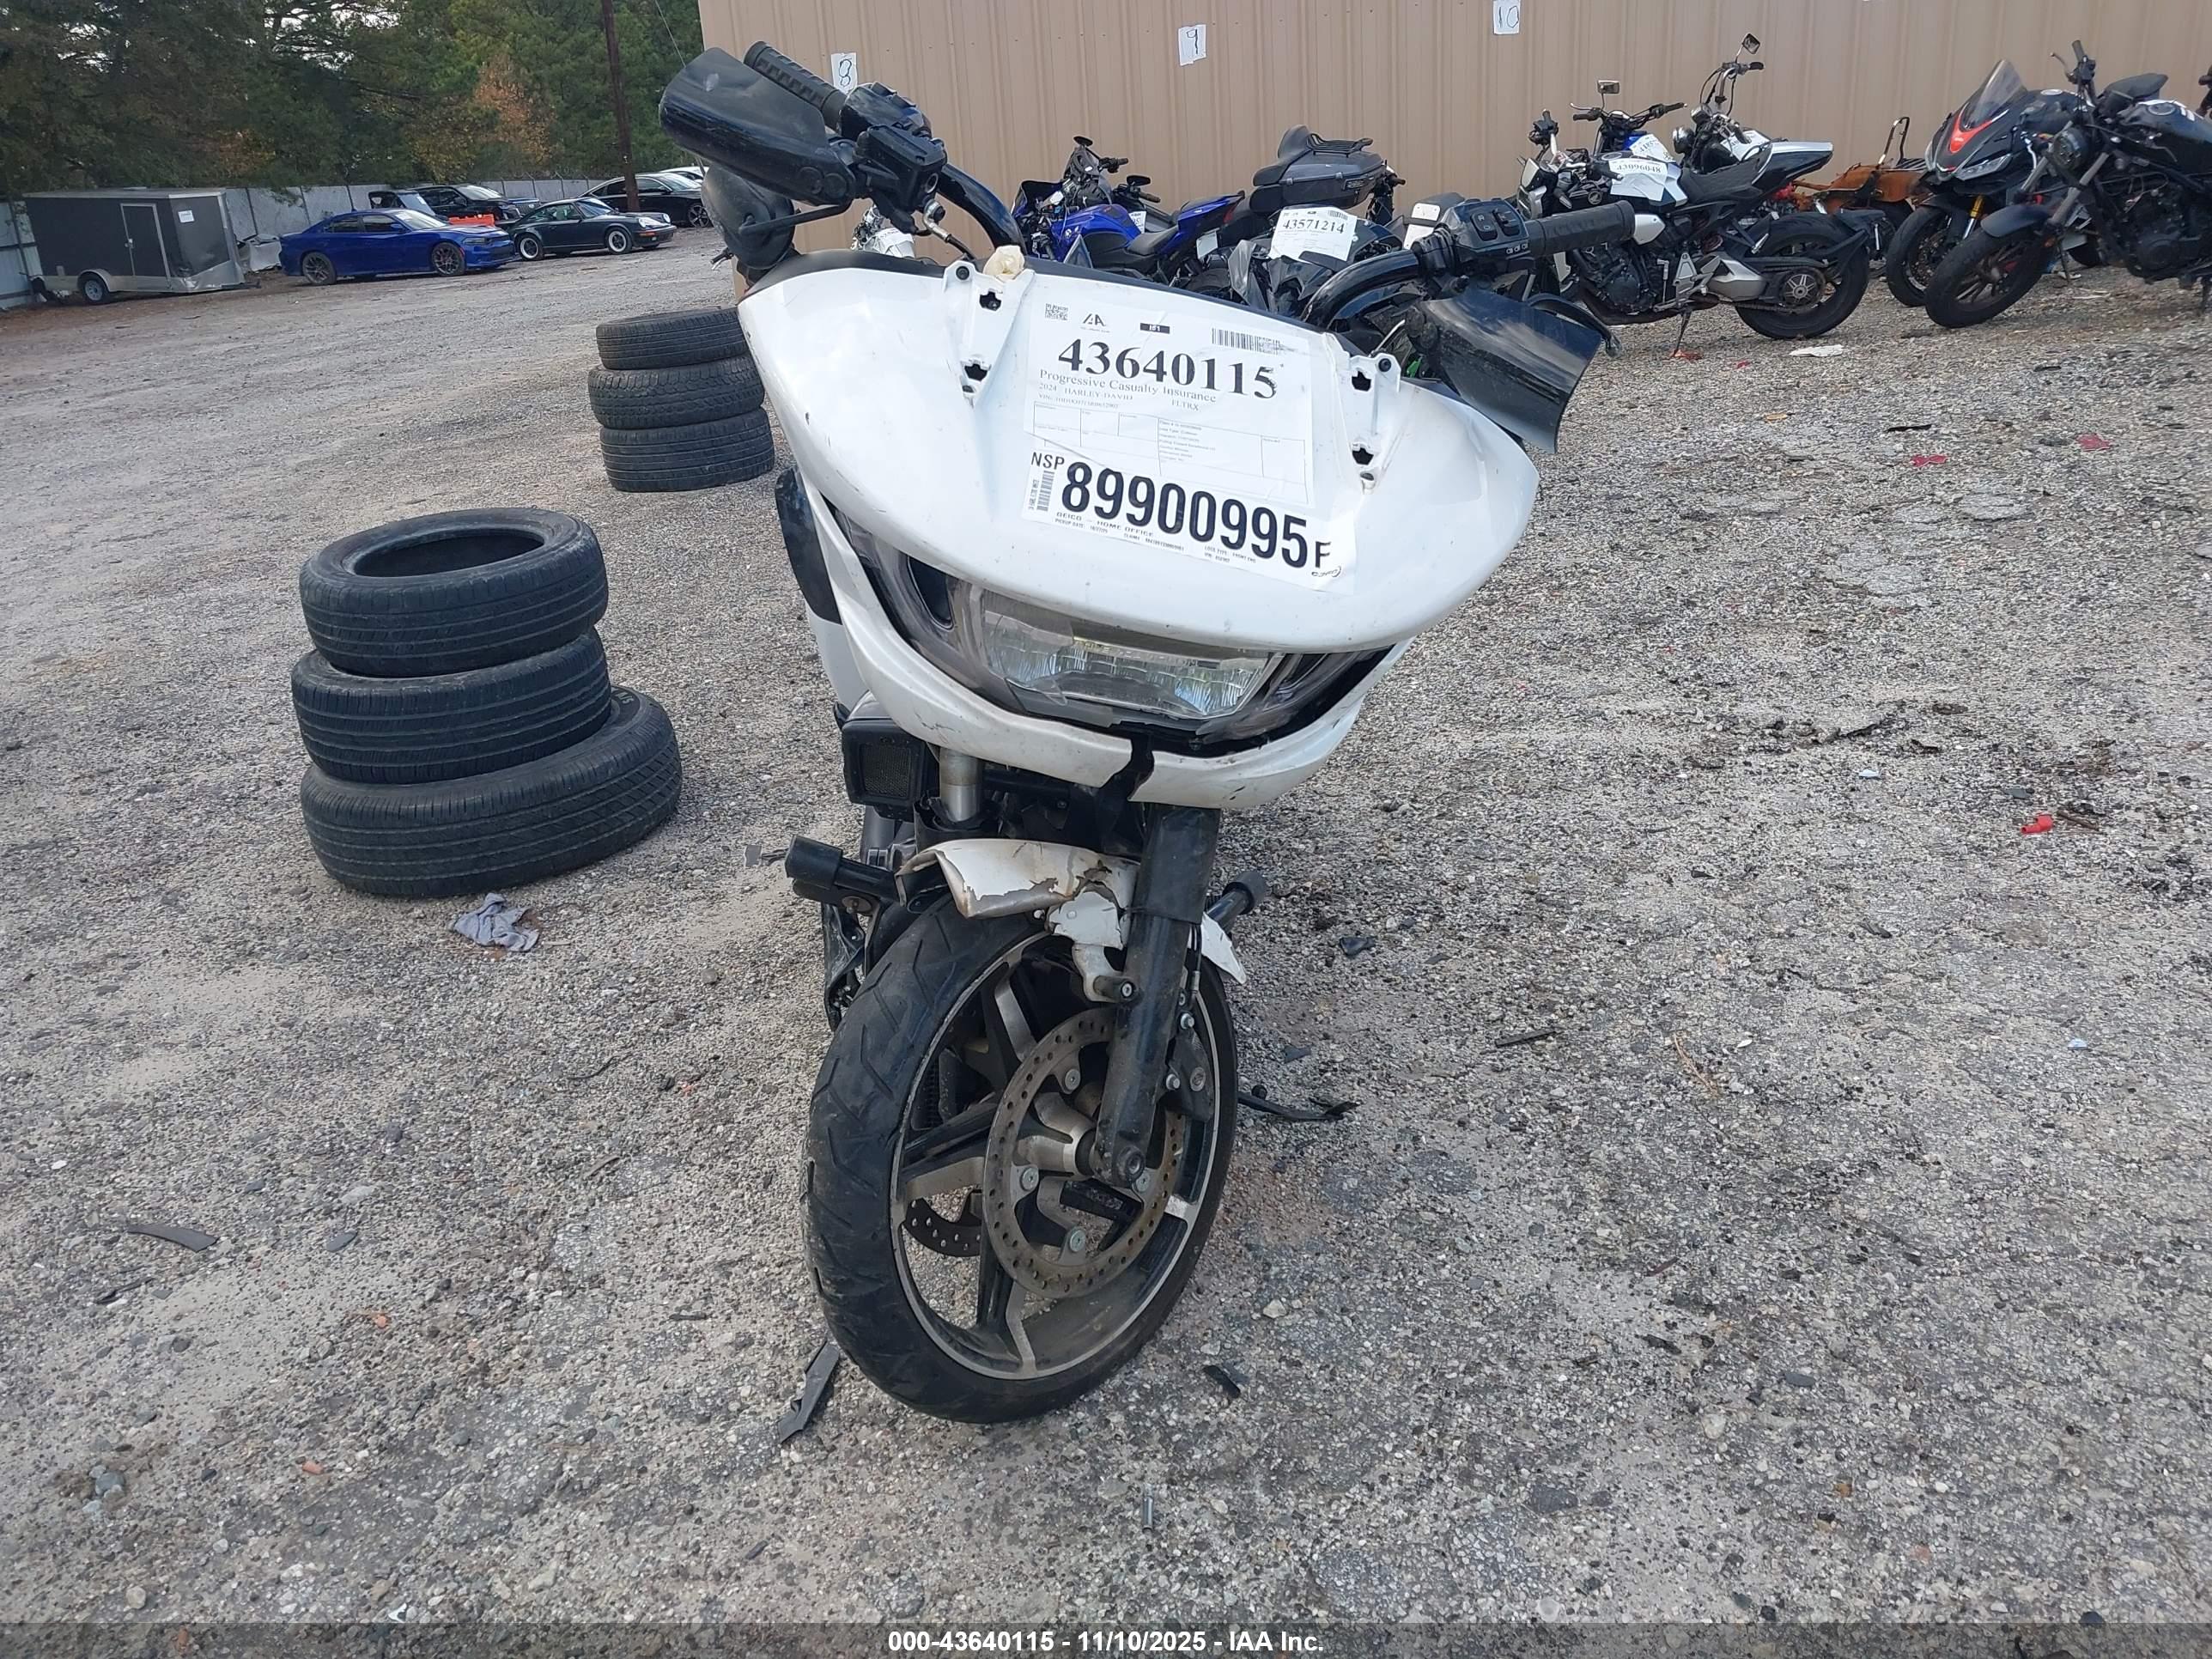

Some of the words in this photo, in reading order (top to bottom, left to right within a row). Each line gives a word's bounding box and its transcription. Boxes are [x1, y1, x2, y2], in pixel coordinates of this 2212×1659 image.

[1498, 5, 1519, 28] 10
[1186, 28, 1199, 55] 9
[839, 58, 853, 87] 8
[1282, 219, 1345, 234] 43571214
[1058, 338, 1278, 399] 43640115
[1038, 383, 1057, 392] 2024
[1039, 368, 1106, 388] Progressive
[1109, 380, 1158, 396] Casualty
[1163, 386, 1217, 403] Insurance
[1030, 452, 1066, 471] NSP
[1056, 511, 1082, 522] GEICO
[1097, 520, 1121, 532] HOME
[1125, 526, 1154, 537] OFFICE
[1061, 462, 1308, 568] 89900995
[1315, 541, 1332, 568] F
